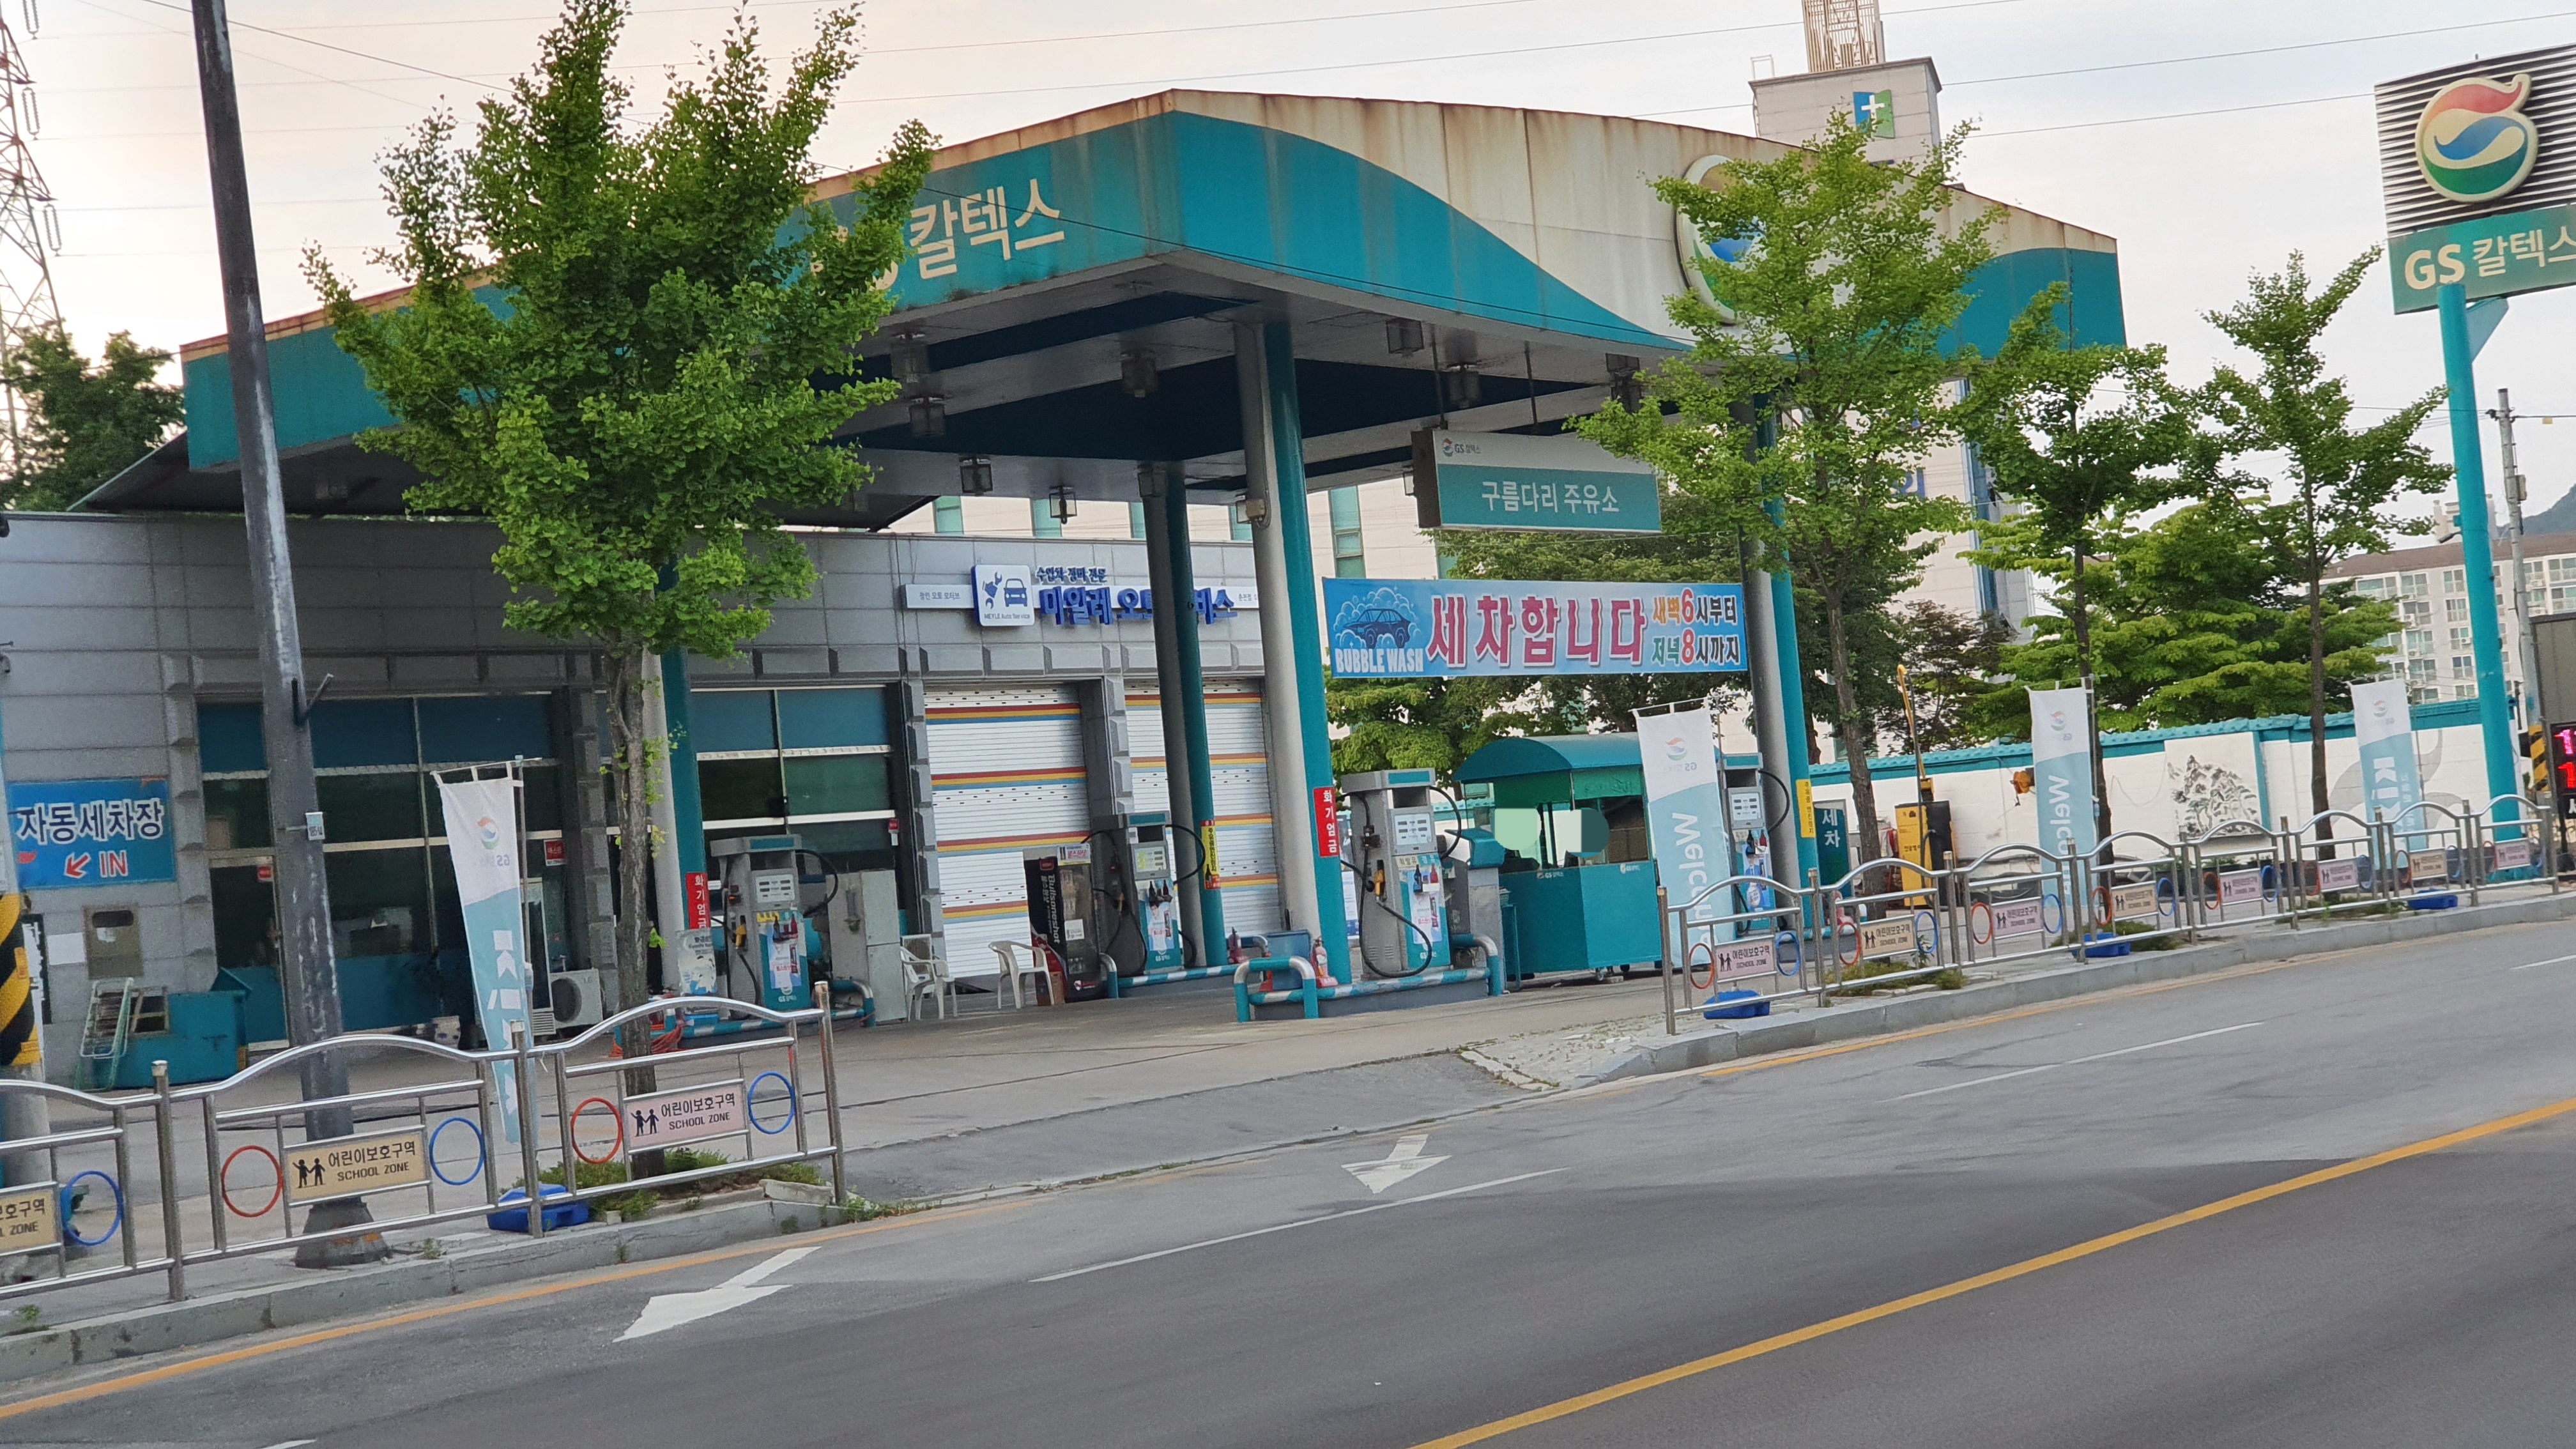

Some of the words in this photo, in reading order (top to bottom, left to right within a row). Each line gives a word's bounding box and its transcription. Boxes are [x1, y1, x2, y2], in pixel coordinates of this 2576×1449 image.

[909, 178, 1065, 280] 칼텍스
[2405, 243, 2465, 290] GS
[2473, 226, 2576, 277] 칼텍스
[1454, 443, 1464, 453] GS
[1482, 480, 1559, 512] 구름다리
[1563, 484, 1620, 514] 주유소
[1036, 566, 1064, 582] 수입차
[1067, 566, 1086, 582] 정비
[1088, 567, 1108, 583] 전문
[1652, 588, 1737, 626] 새벽6시부터
[1426, 594, 1648, 668] 세차합니다
[1335, 648, 1386, 673] BUBBLE
[1387, 647, 1424, 673] WASH
[1650, 629, 1741, 666] 저녁8시까지
[17, 797, 165, 845] 자동세차장
[1323, 789, 1337, 853] 화기엄금
[1821, 809, 1841, 848] 세차
[98, 849, 128, 878] IN
[1048, 873, 1061, 944] Bullsoneshot
[1732, 945, 1770, 960] 어린이보호구역
[661, 1092, 735, 1117] 어린이보호구역
[669, 1116, 705, 1130] SCHOOL
[709, 1112, 730, 1123] ZONE
[328, 1140, 416, 1168] 어린이보호구역
[337, 1166, 380, 1182] SCHOOL
[384, 1161, 410, 1174] ZONE
[0, 1197, 45, 1220] 호구역
[9, 1221, 39, 1236] ZONE
